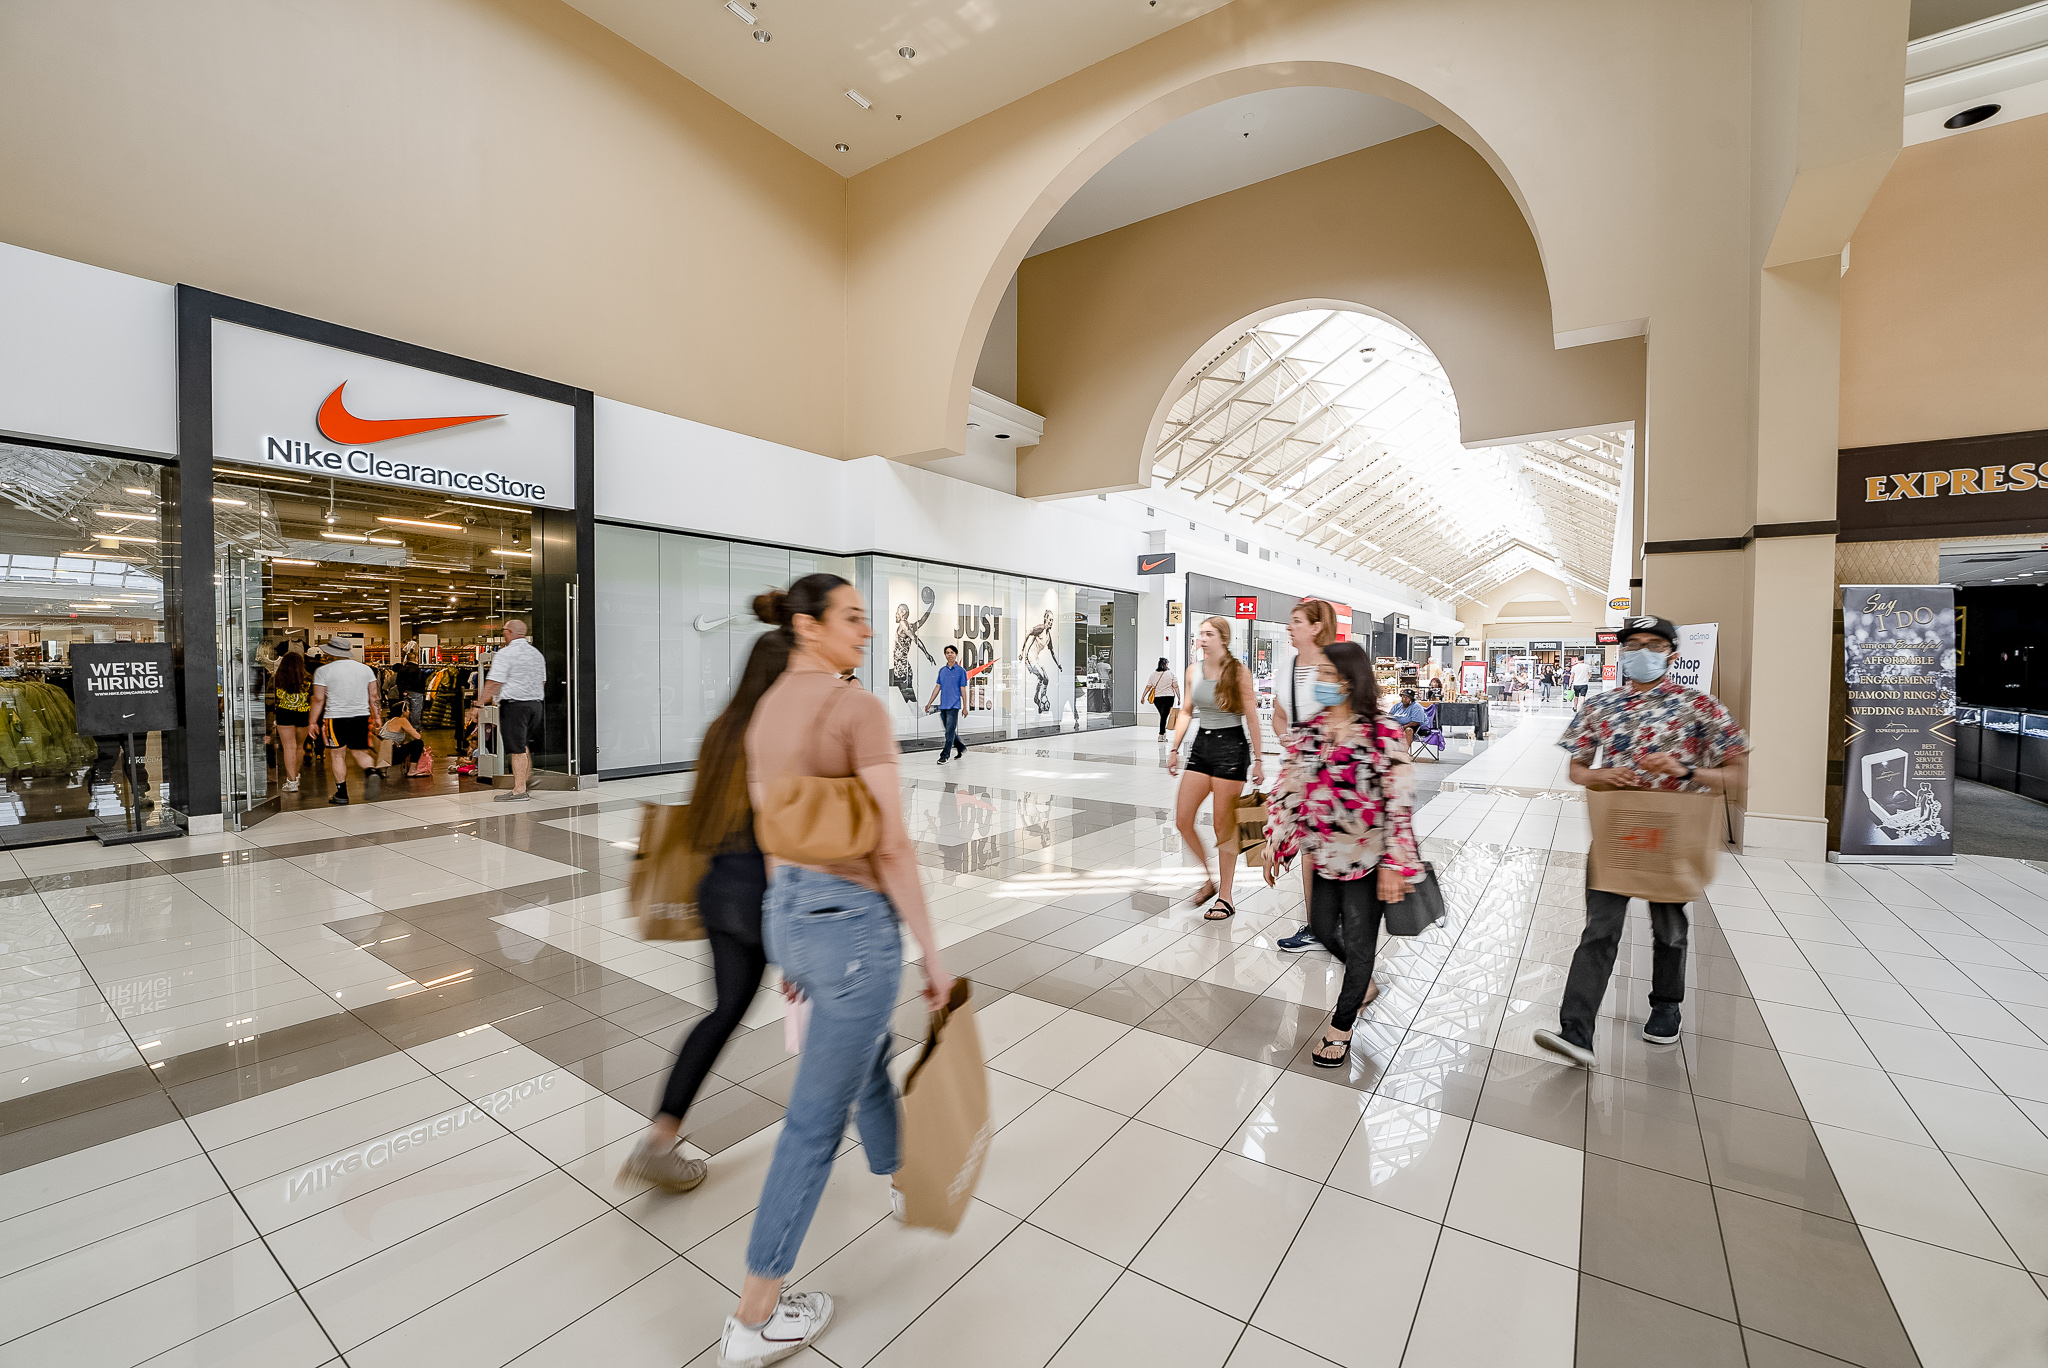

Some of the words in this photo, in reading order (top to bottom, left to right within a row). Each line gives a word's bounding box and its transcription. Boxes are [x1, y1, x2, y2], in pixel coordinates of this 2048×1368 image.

[267, 436, 342, 470] Nike
[1863, 593, 1898, 616] Say
[954, 604, 1002, 640] JUST
[1876, 614, 1888, 632] I
[1894, 606, 1934, 630] DO
[1894, 640, 1944, 652] Beautiful
[963, 640, 994, 674] DO
[1674, 657, 1700, 672] Shop
[1864, 656, 1934, 665] AFFORDABLE
[90, 662, 158, 676] WE'RE
[88, 676, 164, 691] HIRING!
[1860, 676, 1935, 684] ENGAGEMENT
[1848, 690, 1900, 699] DIAMOND
[1903, 690, 1936, 699] RINGS
[1940, 691, 1949, 700] &
[1852, 707, 1904, 716] WEDDING
[1907, 707, 1944, 716] BANDS
